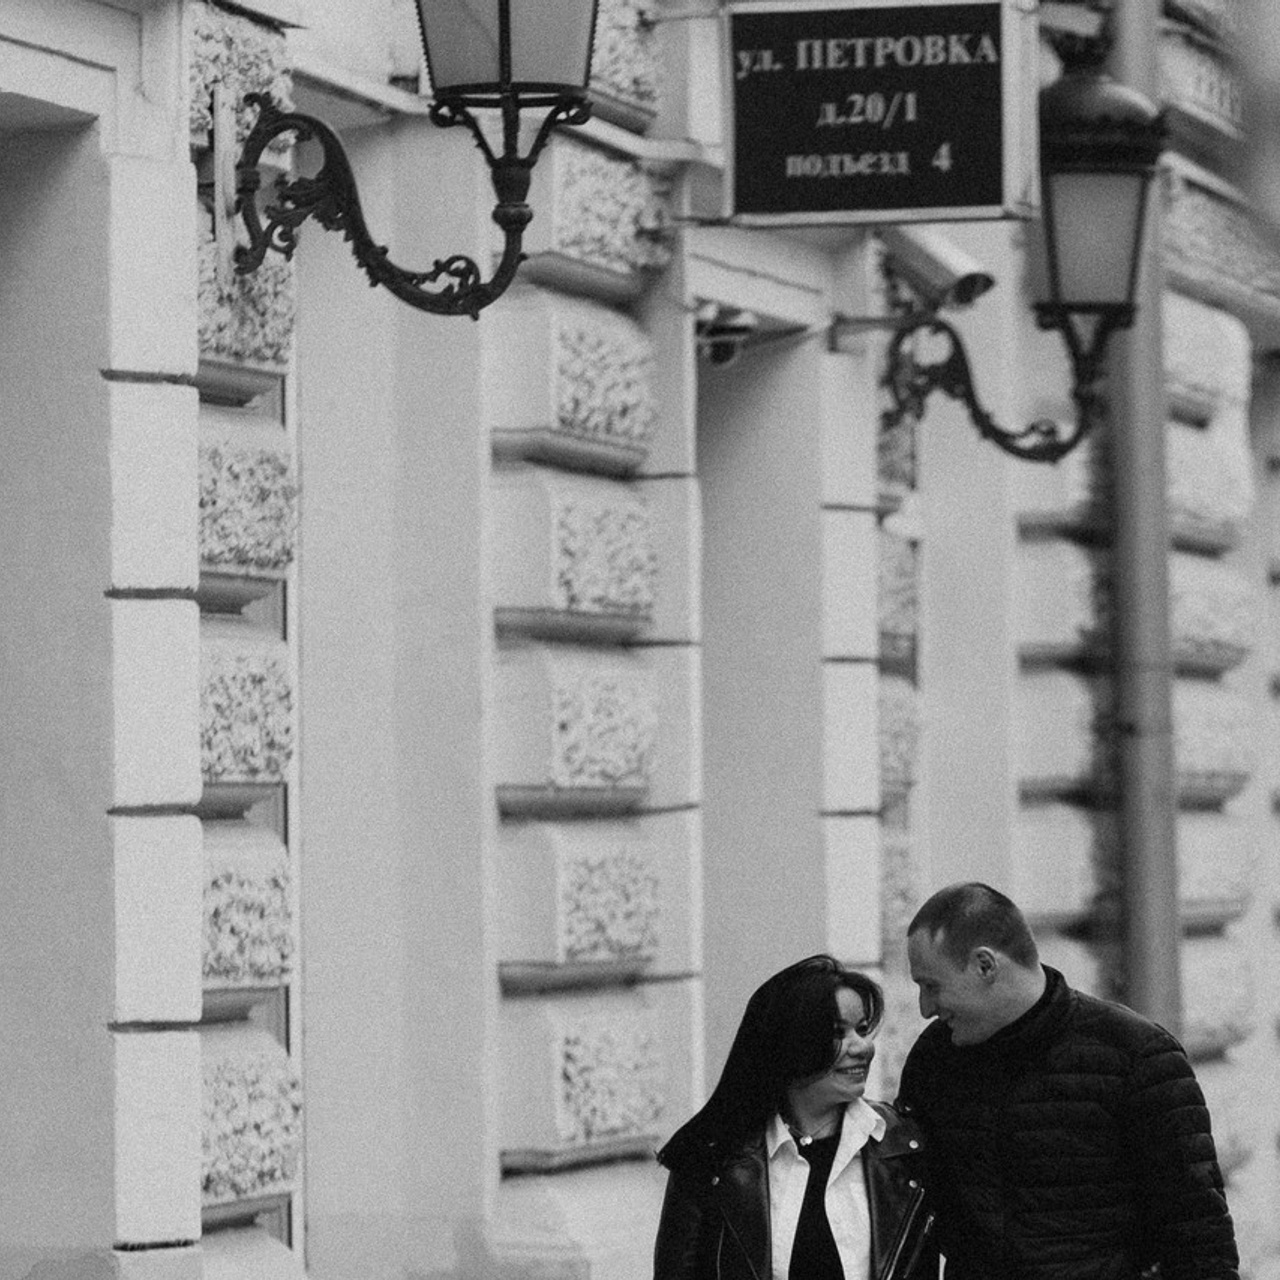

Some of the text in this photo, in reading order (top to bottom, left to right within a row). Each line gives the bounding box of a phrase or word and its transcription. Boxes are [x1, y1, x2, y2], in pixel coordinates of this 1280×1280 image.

[737, 34, 998, 80] ул. ПЕТРОВКА
[931, 142, 953, 172] 4
